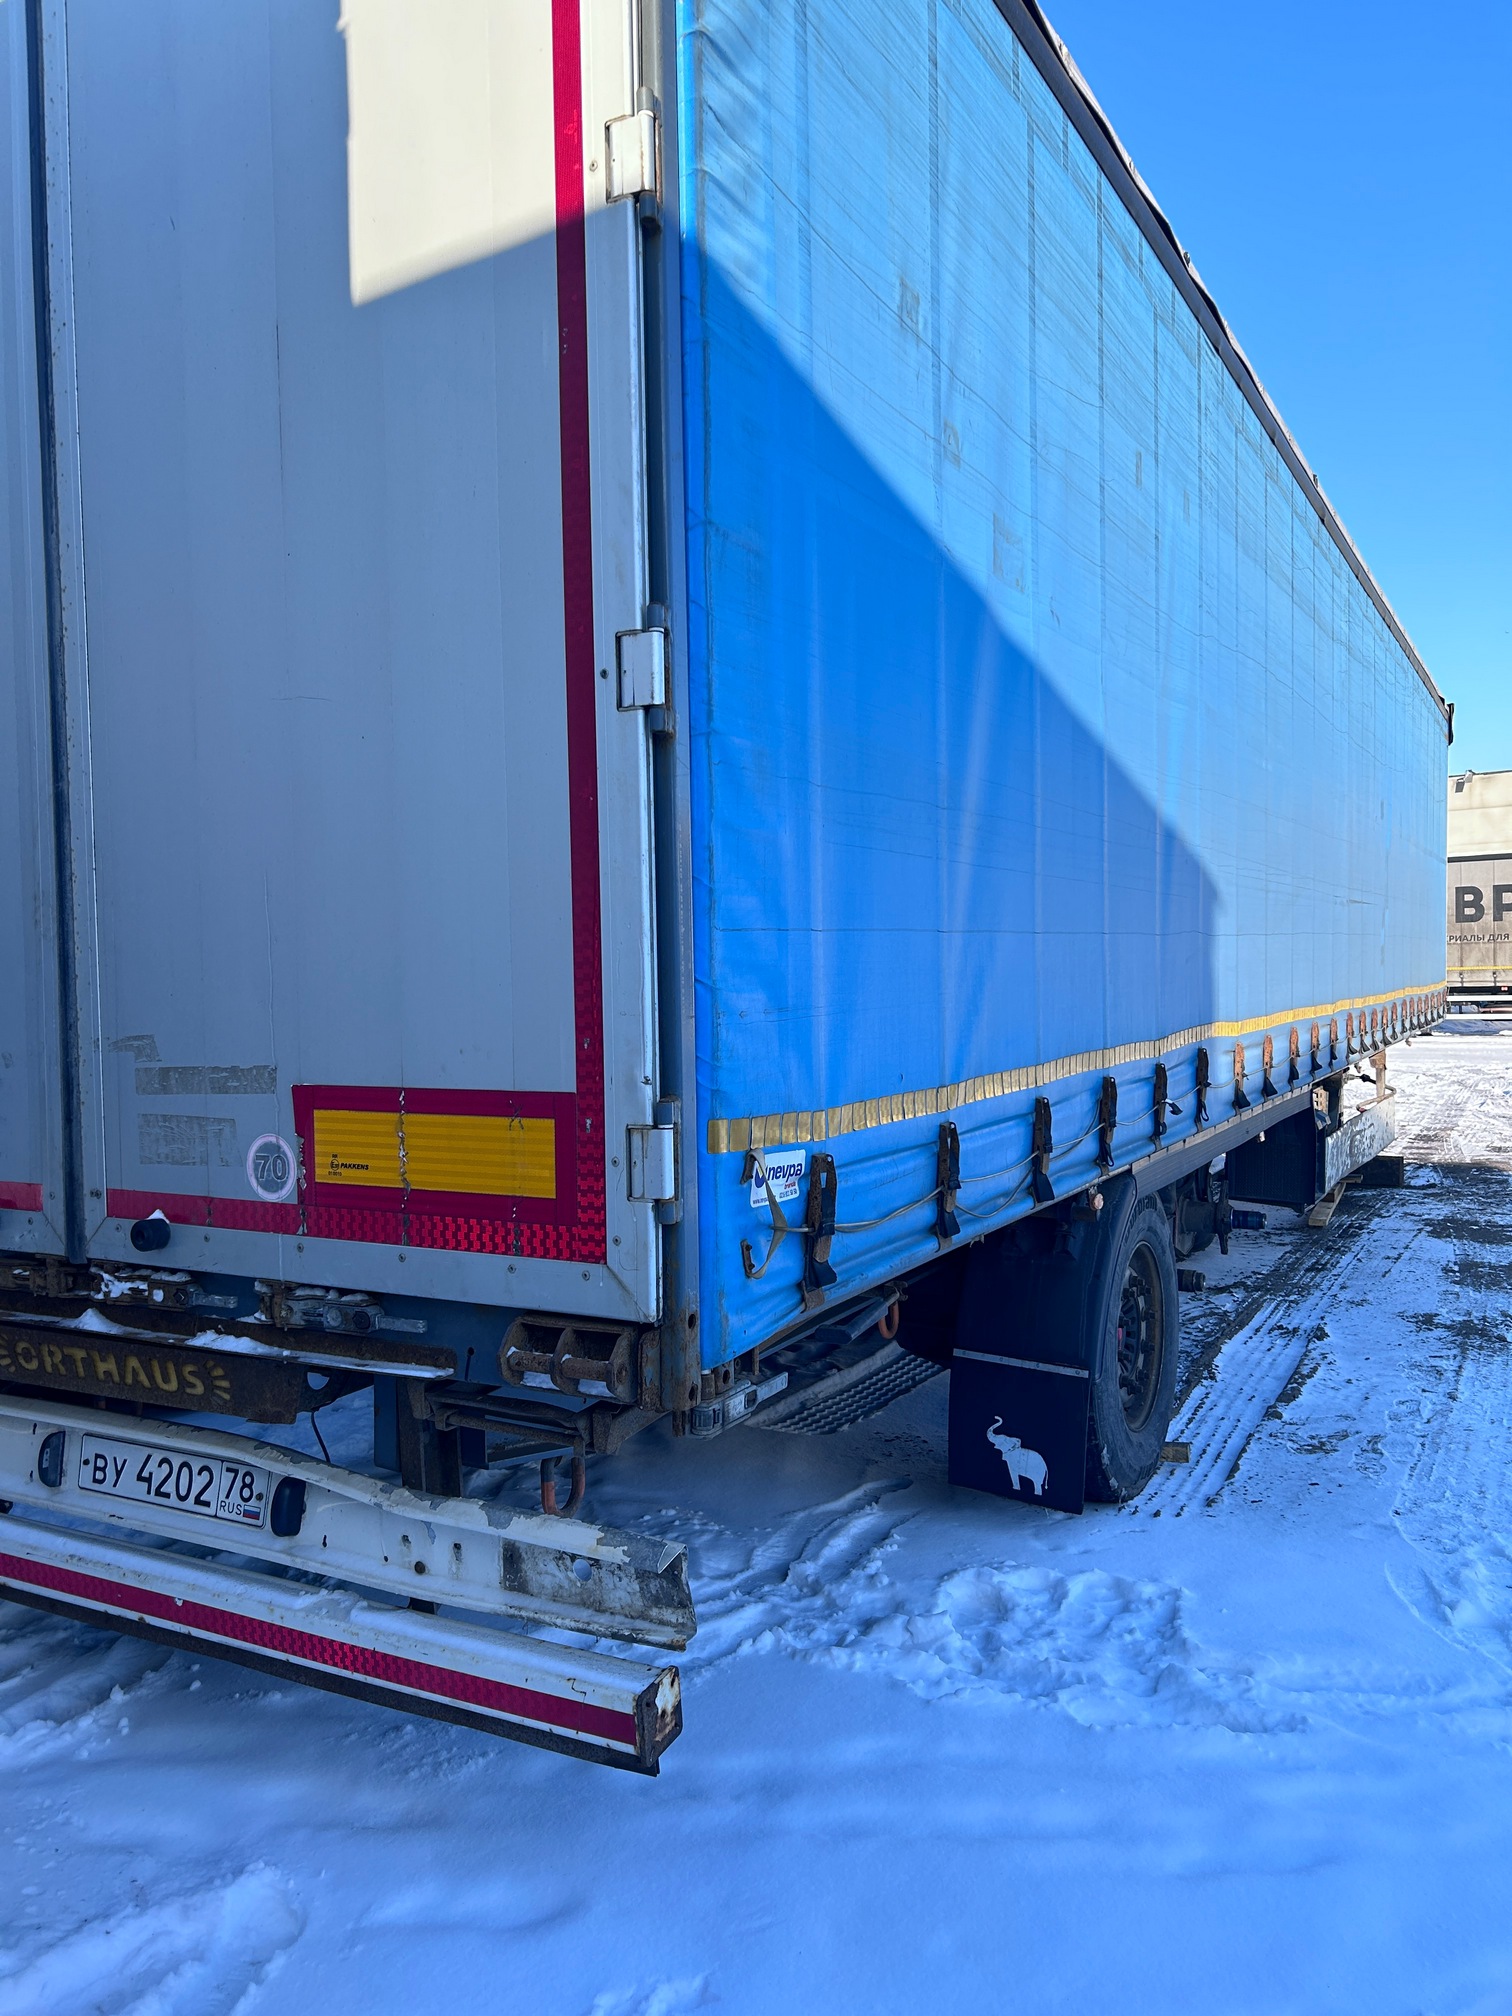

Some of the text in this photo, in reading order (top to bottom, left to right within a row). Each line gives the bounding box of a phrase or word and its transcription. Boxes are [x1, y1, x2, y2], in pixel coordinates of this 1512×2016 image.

[1447, 933, 1510, 943] РИАЛЫ ДЛЯ
[254, 1153, 288, 1181] 70
[340, 1162, 370, 1171] PAKKENS
[767, 1162, 803, 1183] nevpa
[14, 1341, 205, 1395] ORTHAUS
[136, 1454, 215, 1508] 4202
[223, 1467, 256, 1502] 78
[219, 1501, 243, 1516] RUS
